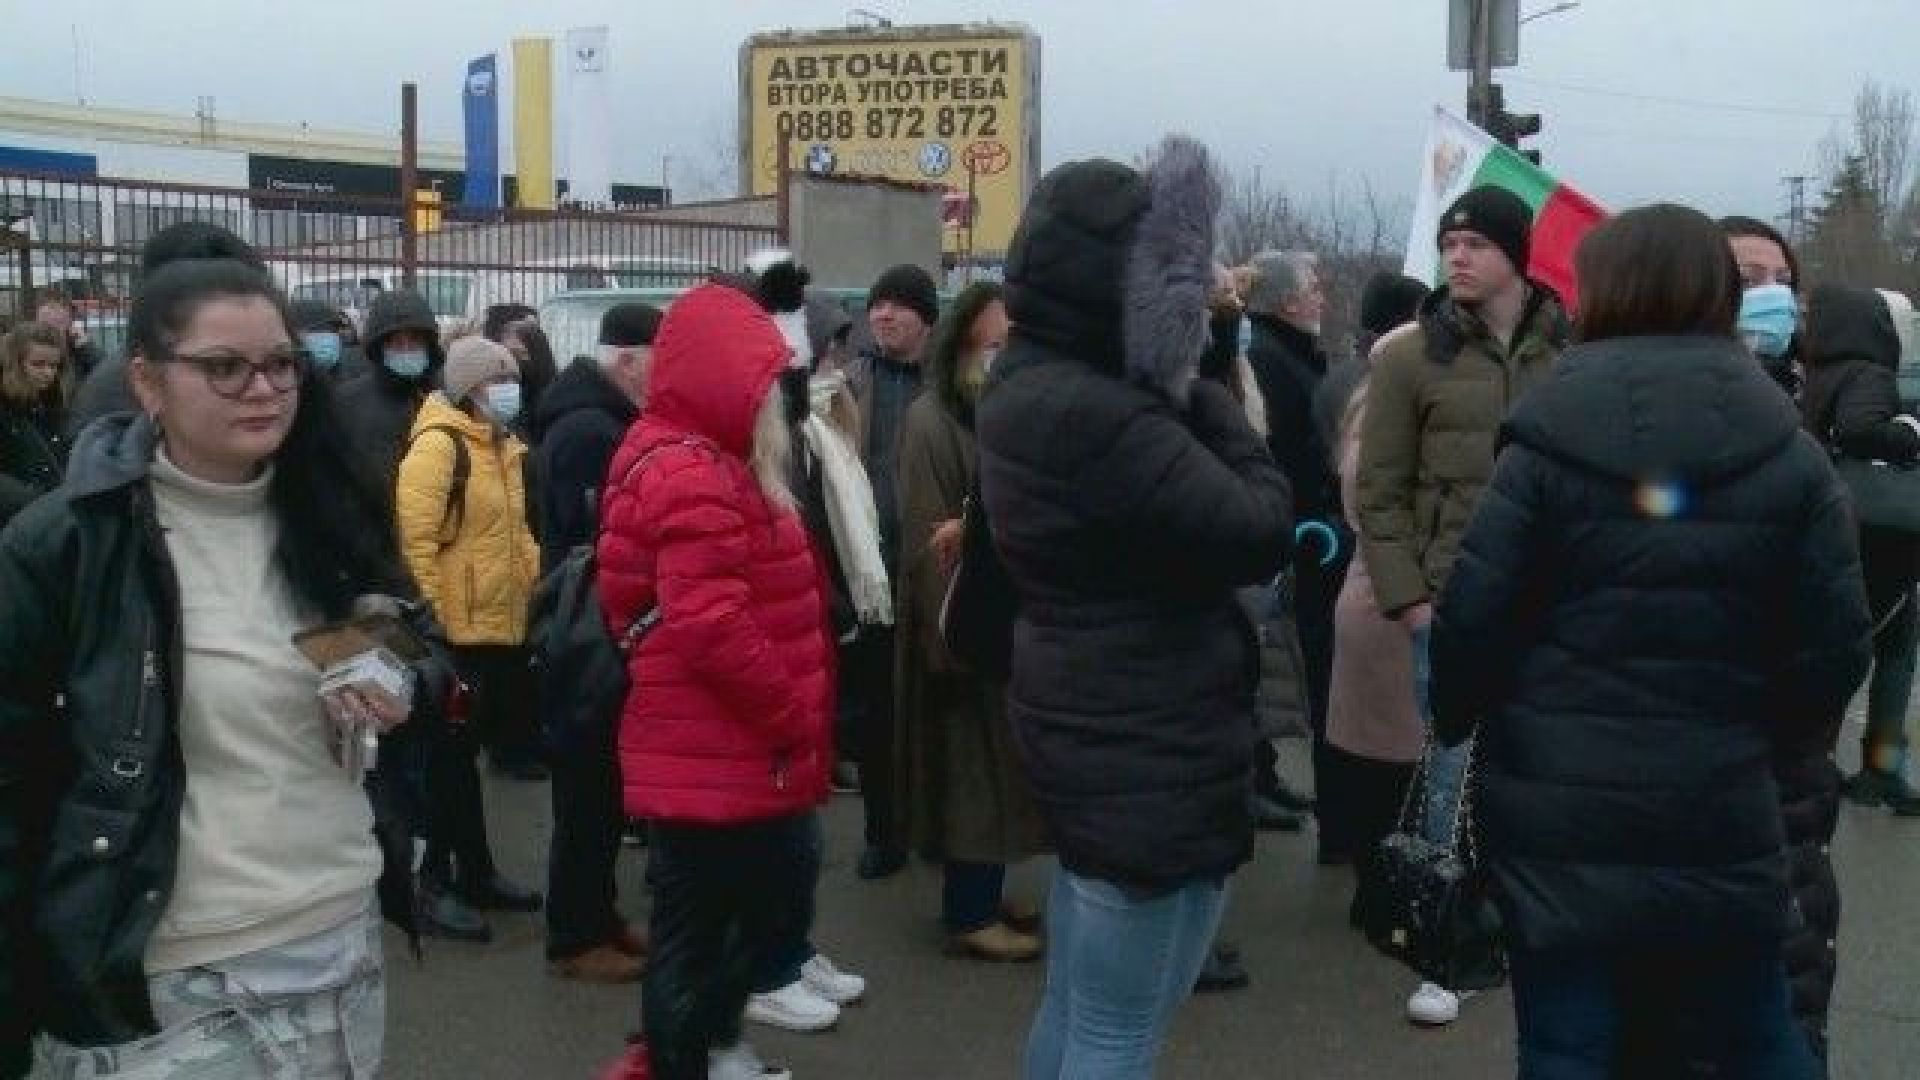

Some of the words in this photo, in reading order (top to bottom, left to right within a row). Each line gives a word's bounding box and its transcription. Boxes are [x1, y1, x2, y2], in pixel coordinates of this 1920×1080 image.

[769, 48, 1008, 82] АВТОЧАСТИ
[768, 83, 847, 105] ВТОРА
[857, 77, 1008, 103] УПОТРЕБА
[776, 109, 853, 141] 0888
[865, 107, 925, 138] 872
[938, 105, 997, 136] 872
